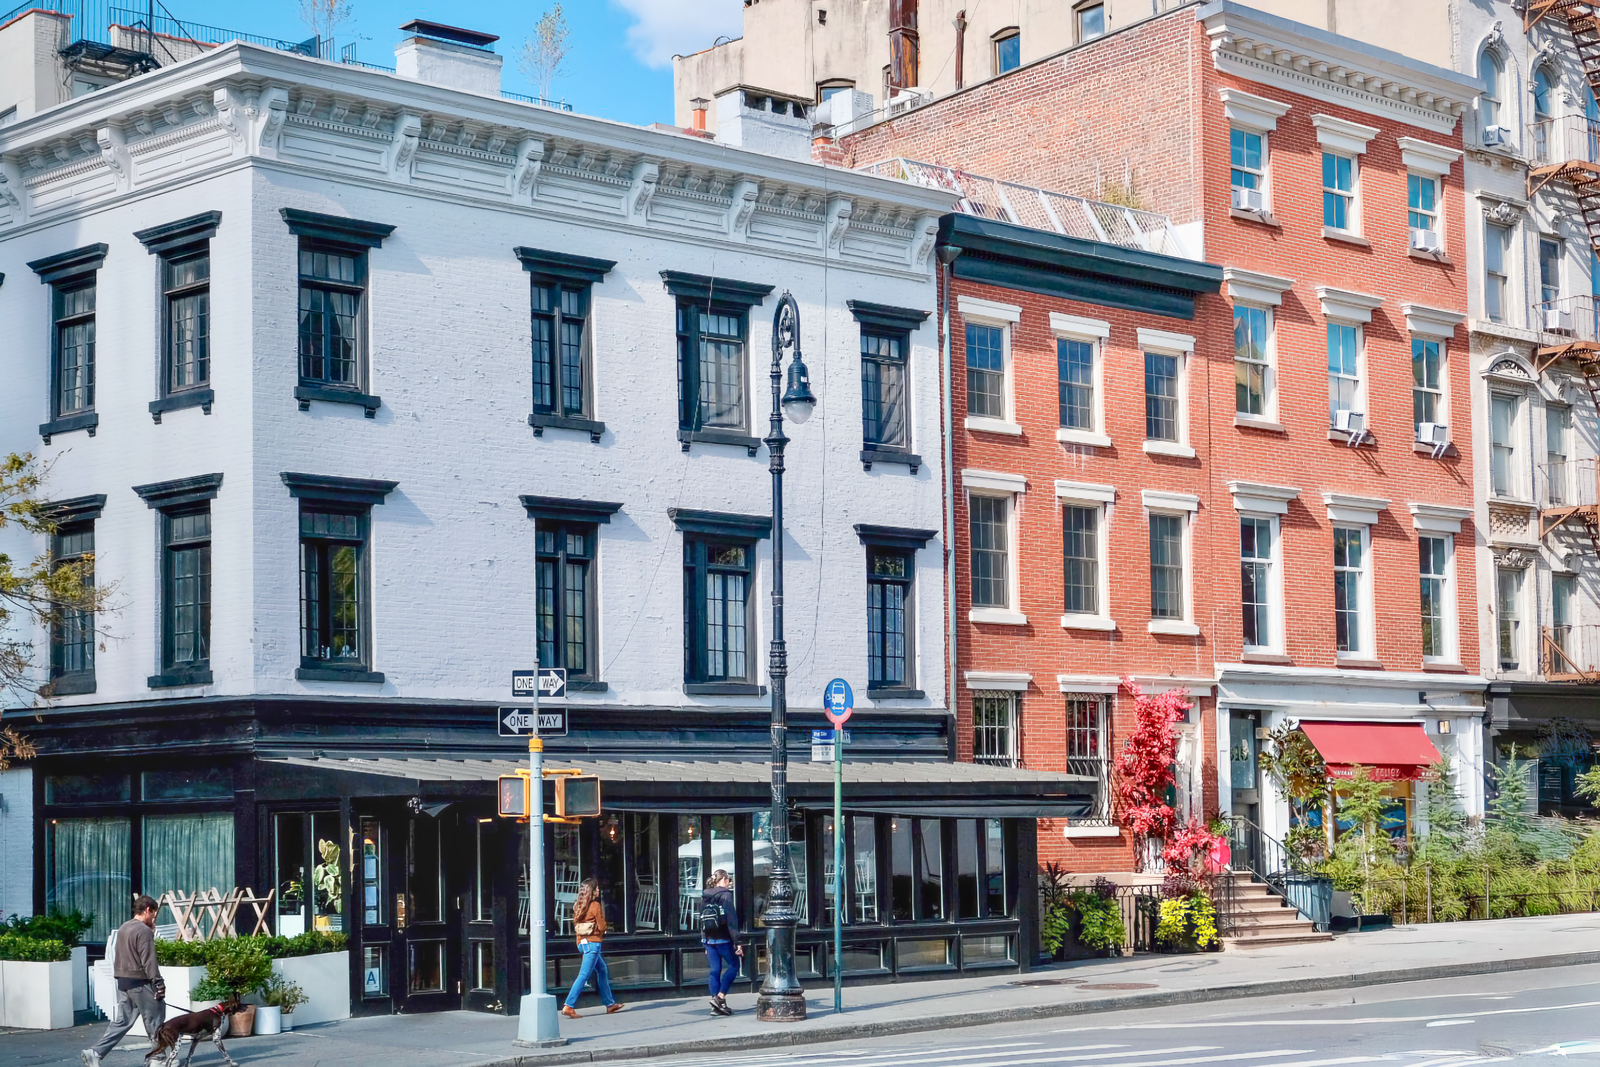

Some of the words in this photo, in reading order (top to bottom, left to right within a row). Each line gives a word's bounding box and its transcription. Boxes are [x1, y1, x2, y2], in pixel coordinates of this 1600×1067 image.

[516, 678, 533, 689] ONE
[542, 678, 559, 689] WAY
[510, 715, 529, 727] ONE
[538, 715, 558, 727] WAY
[366, 971, 377, 985] A
